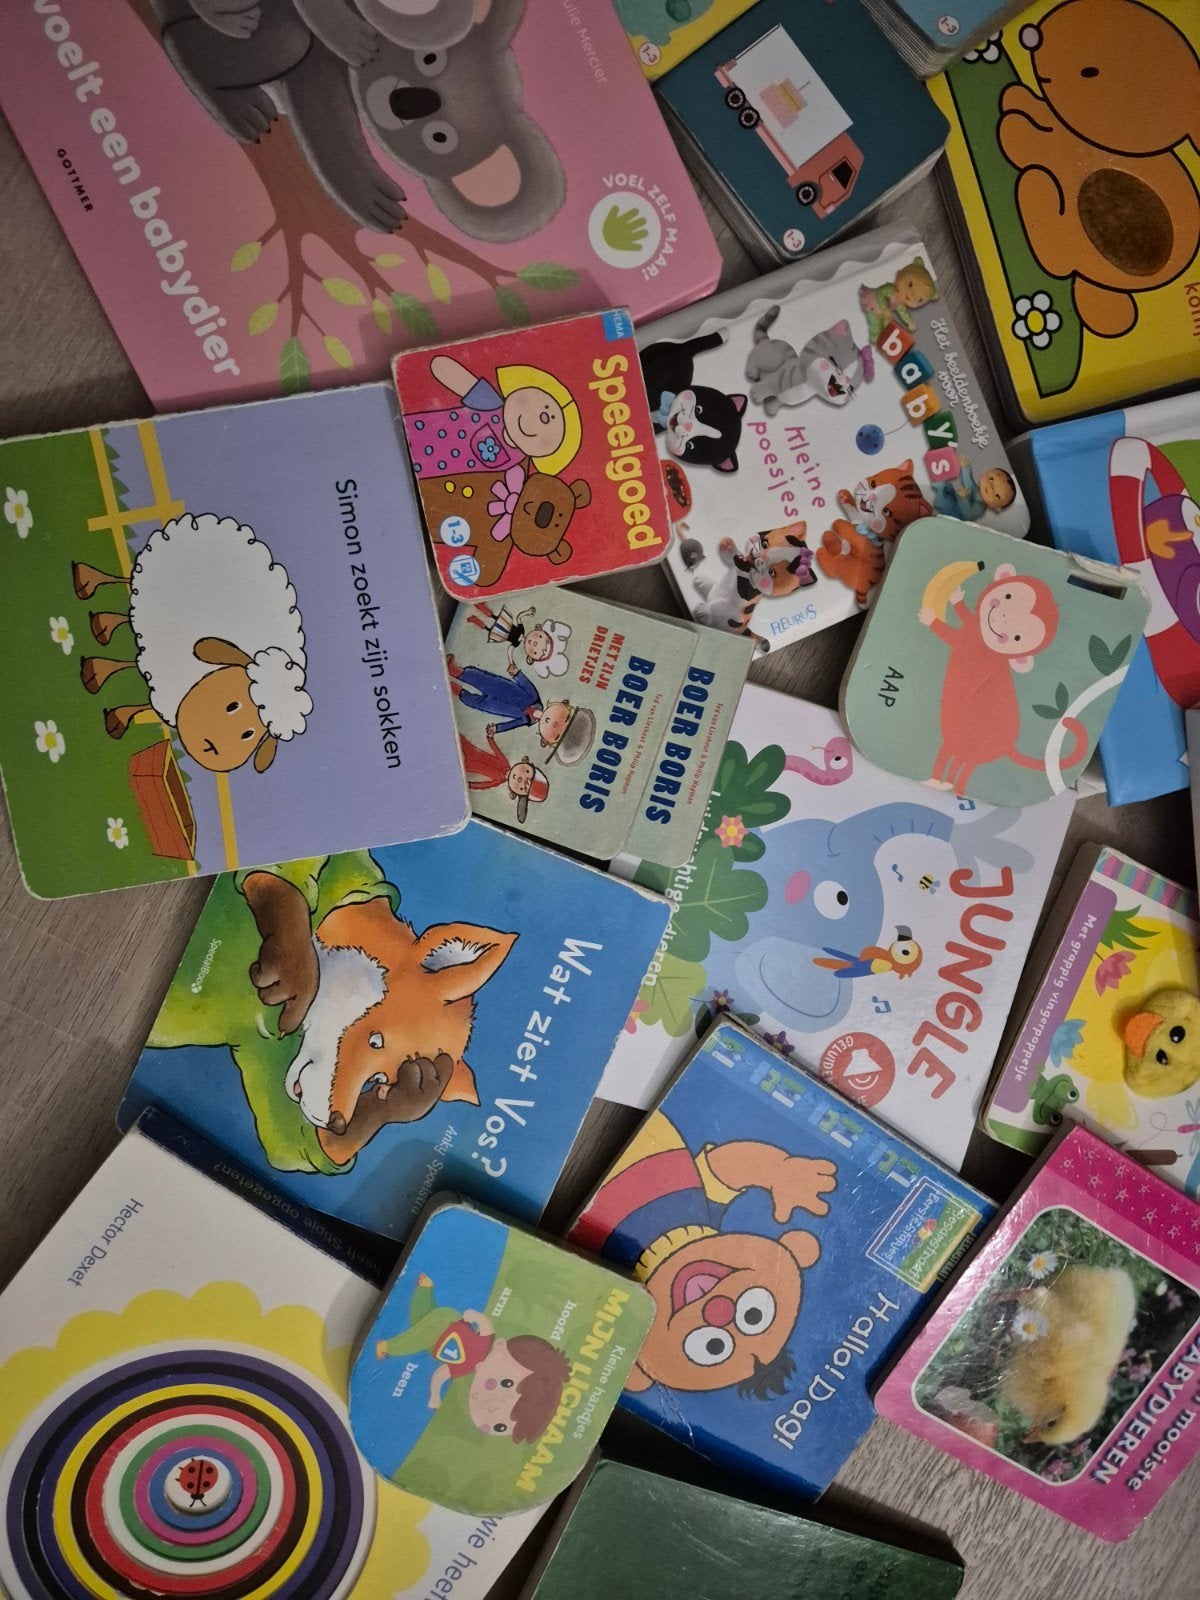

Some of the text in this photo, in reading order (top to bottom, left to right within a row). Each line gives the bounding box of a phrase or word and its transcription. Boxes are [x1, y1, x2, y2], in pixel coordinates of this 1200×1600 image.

[577, 28, 609, 82] Mercier
[642, 45, 658, 63] 1-3
[940, 17, 957, 34] 1-3
[33, 0, 241, 376] voelt een babydier
[57, 148, 93, 212] GOTTMER
[602, 172, 679, 282] VOEL ZELF MAAR!
[786, 230, 802, 249] 1-3
[611, 310, 625, 339] HEMA
[930, 318, 989, 450] Het beeldenboekje
[938, 370, 959, 408] voor
[588, 354, 663, 550] Speelgoed
[746, 421, 799, 518] poesjes
[448, 520, 464, 544] 1-3
[335, 479, 402, 769] Simon zoekt zijn sokken
[770, 604, 817, 636] FLEURUS
[579, 625, 609, 685] DRIETJES
[595, 632, 626, 691] MET ZIJN
[878, 666, 905, 708] AAP
[654, 692, 662, 705] Ted
[579, 655, 656, 814] BOER BORIS
[645, 666, 716, 825] BOER BORIS
[907, 865, 1014, 1099] JUNGLE
[1014, 914, 1097, 1082] Met grappig vingerpoppetje
[471, 937, 603, 1178] Wat ziet Vos?
[213, 1161, 299, 1219] opgegeten?
[412, 1124, 458, 1214] Anky Spoelstra
[67, 1198, 144, 1287] Hector Dexet
[492, 1286, 512, 1317] arm
[550, 1300, 578, 1342] hoofd
[392, 1362, 419, 1399] been
[443, 1348, 459, 1360] 1
[772, 1291, 900, 1450] Hallo! Dag!
[515, 1288, 630, 1493] MIJN LICHAAM
[573, 1345, 626, 1440] Kleine handjes
[1092, 1335, 1200, 1485] ABYDIEREN
[1128, 1409, 1197, 1491] mooiste
[424, 1552, 478, 1600] heef
